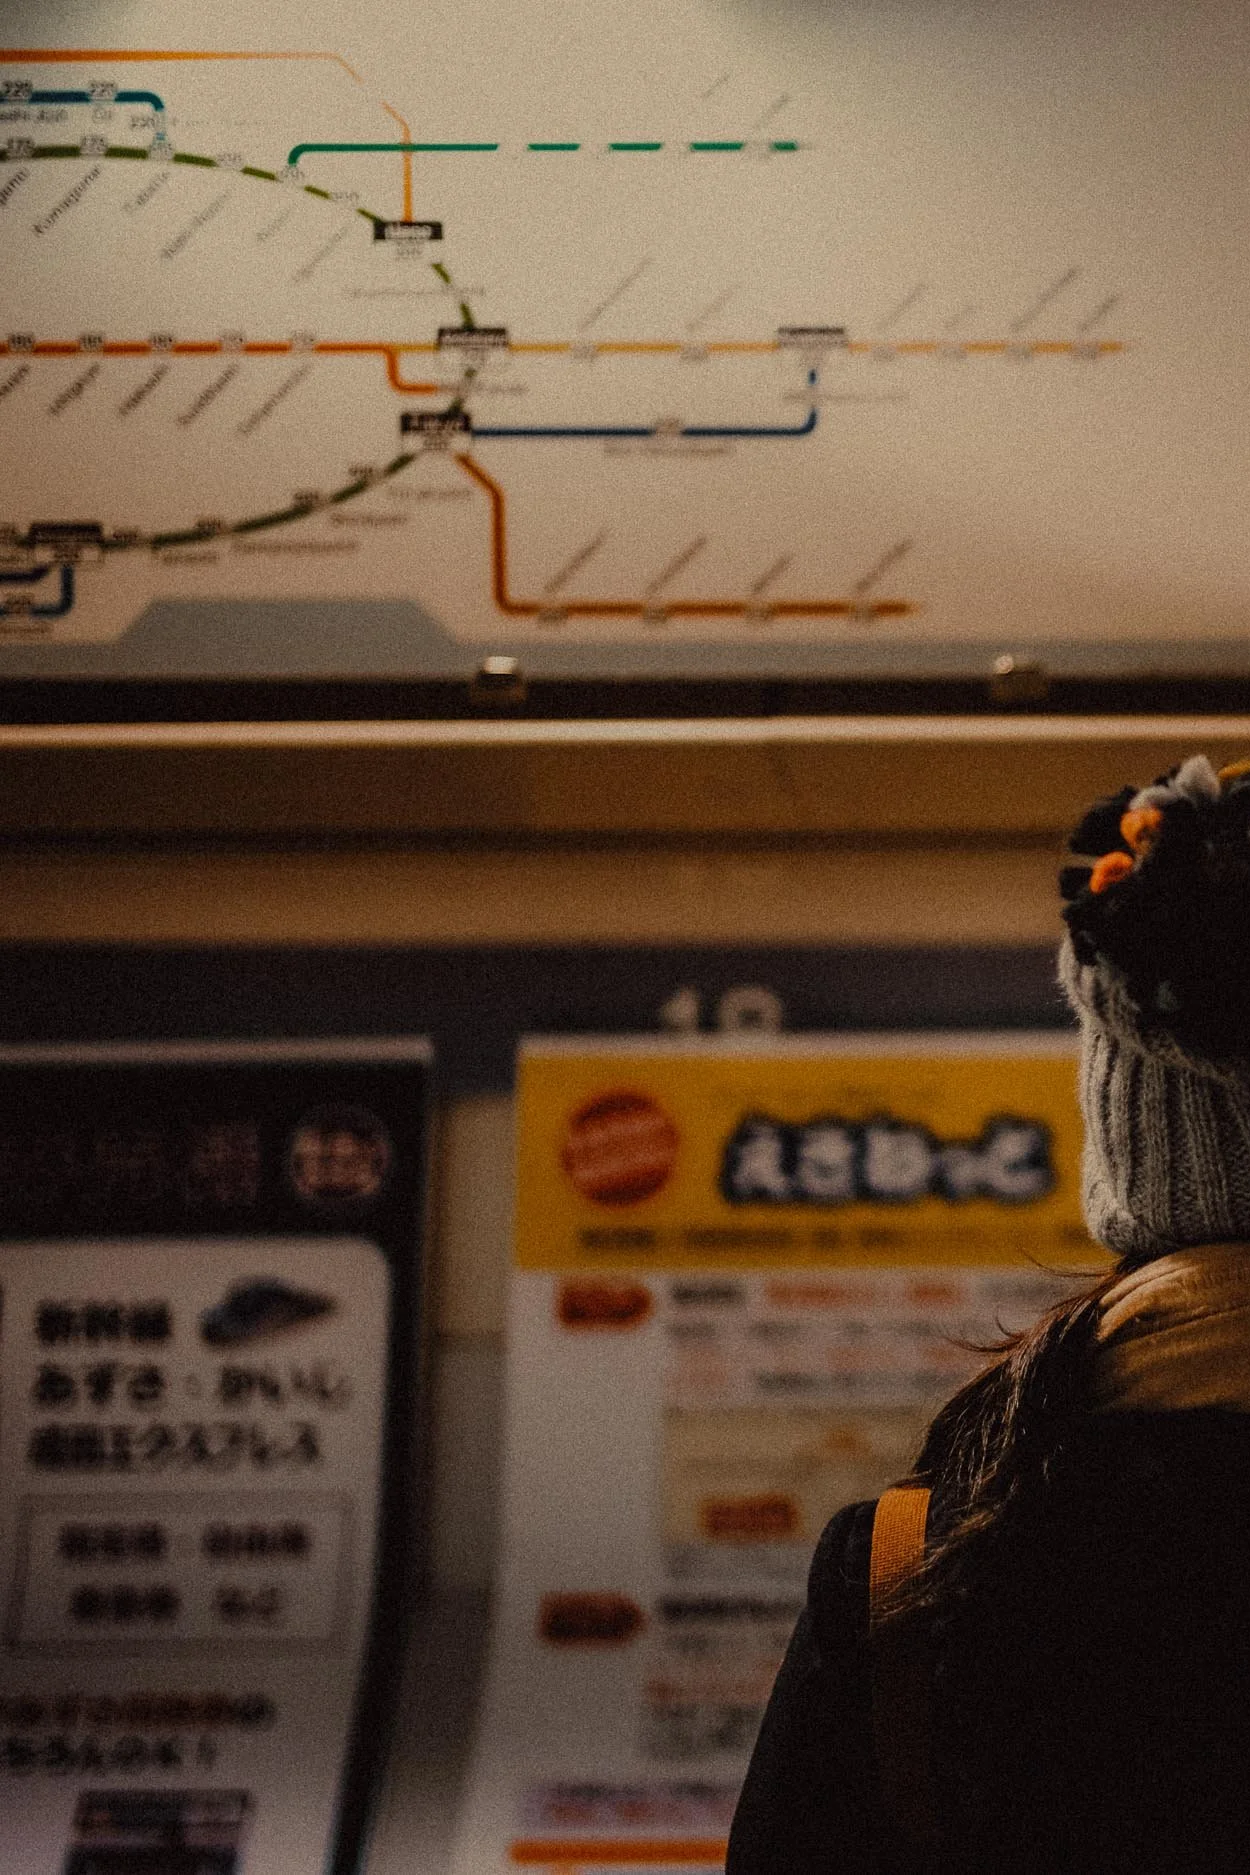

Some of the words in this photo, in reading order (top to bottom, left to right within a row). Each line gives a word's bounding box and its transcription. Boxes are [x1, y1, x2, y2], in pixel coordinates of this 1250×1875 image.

[726, 1113, 1052, 1204] えきねっと
[37, 1303, 172, 1346] 新幹線
